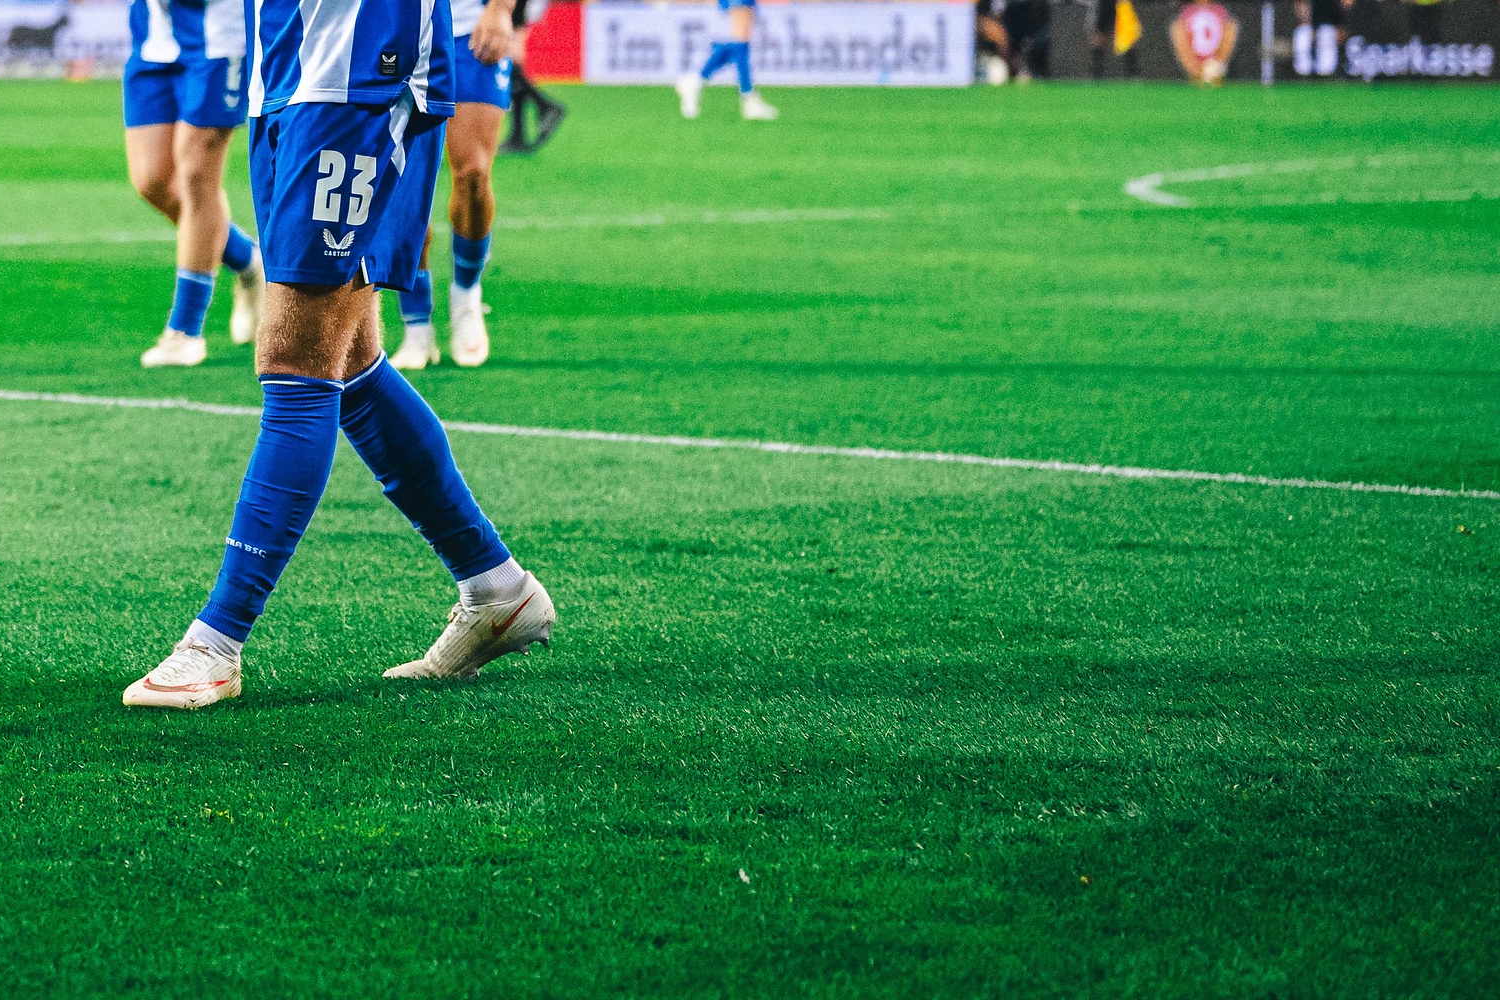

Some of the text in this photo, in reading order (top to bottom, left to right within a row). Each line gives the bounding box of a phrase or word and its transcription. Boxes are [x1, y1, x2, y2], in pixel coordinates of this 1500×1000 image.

[606, 13, 948, 73] Im Fhhandel
[1346, 35, 1493, 81] Sparkasse
[312, 150, 377, 226] 23
[244, 544, 267, 559] BSC
